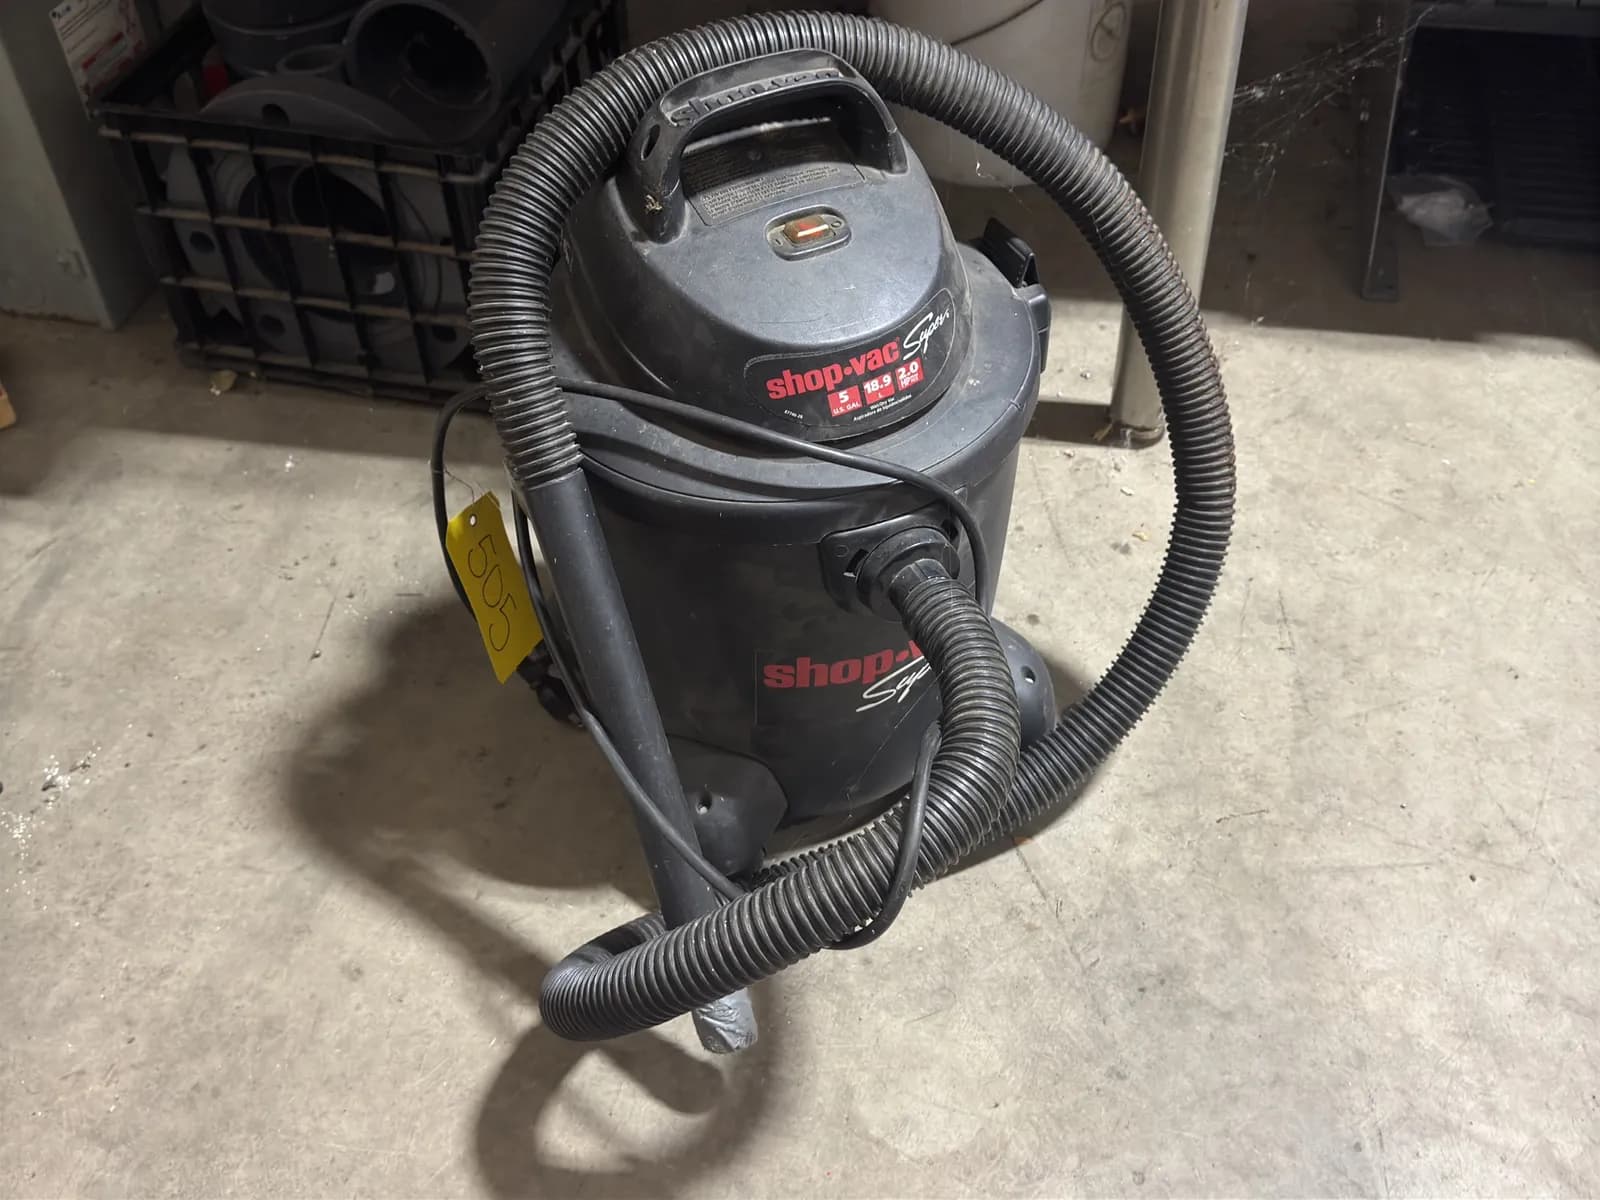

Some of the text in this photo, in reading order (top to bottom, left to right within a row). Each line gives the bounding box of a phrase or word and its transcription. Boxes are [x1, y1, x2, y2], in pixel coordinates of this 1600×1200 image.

[897, 361, 919, 380] 2.0
[863, 374, 892, 394] 18.9
[838, 391, 850, 404] 5
[846, 402, 861, 411] GAL
[467, 533, 519, 653] 505
